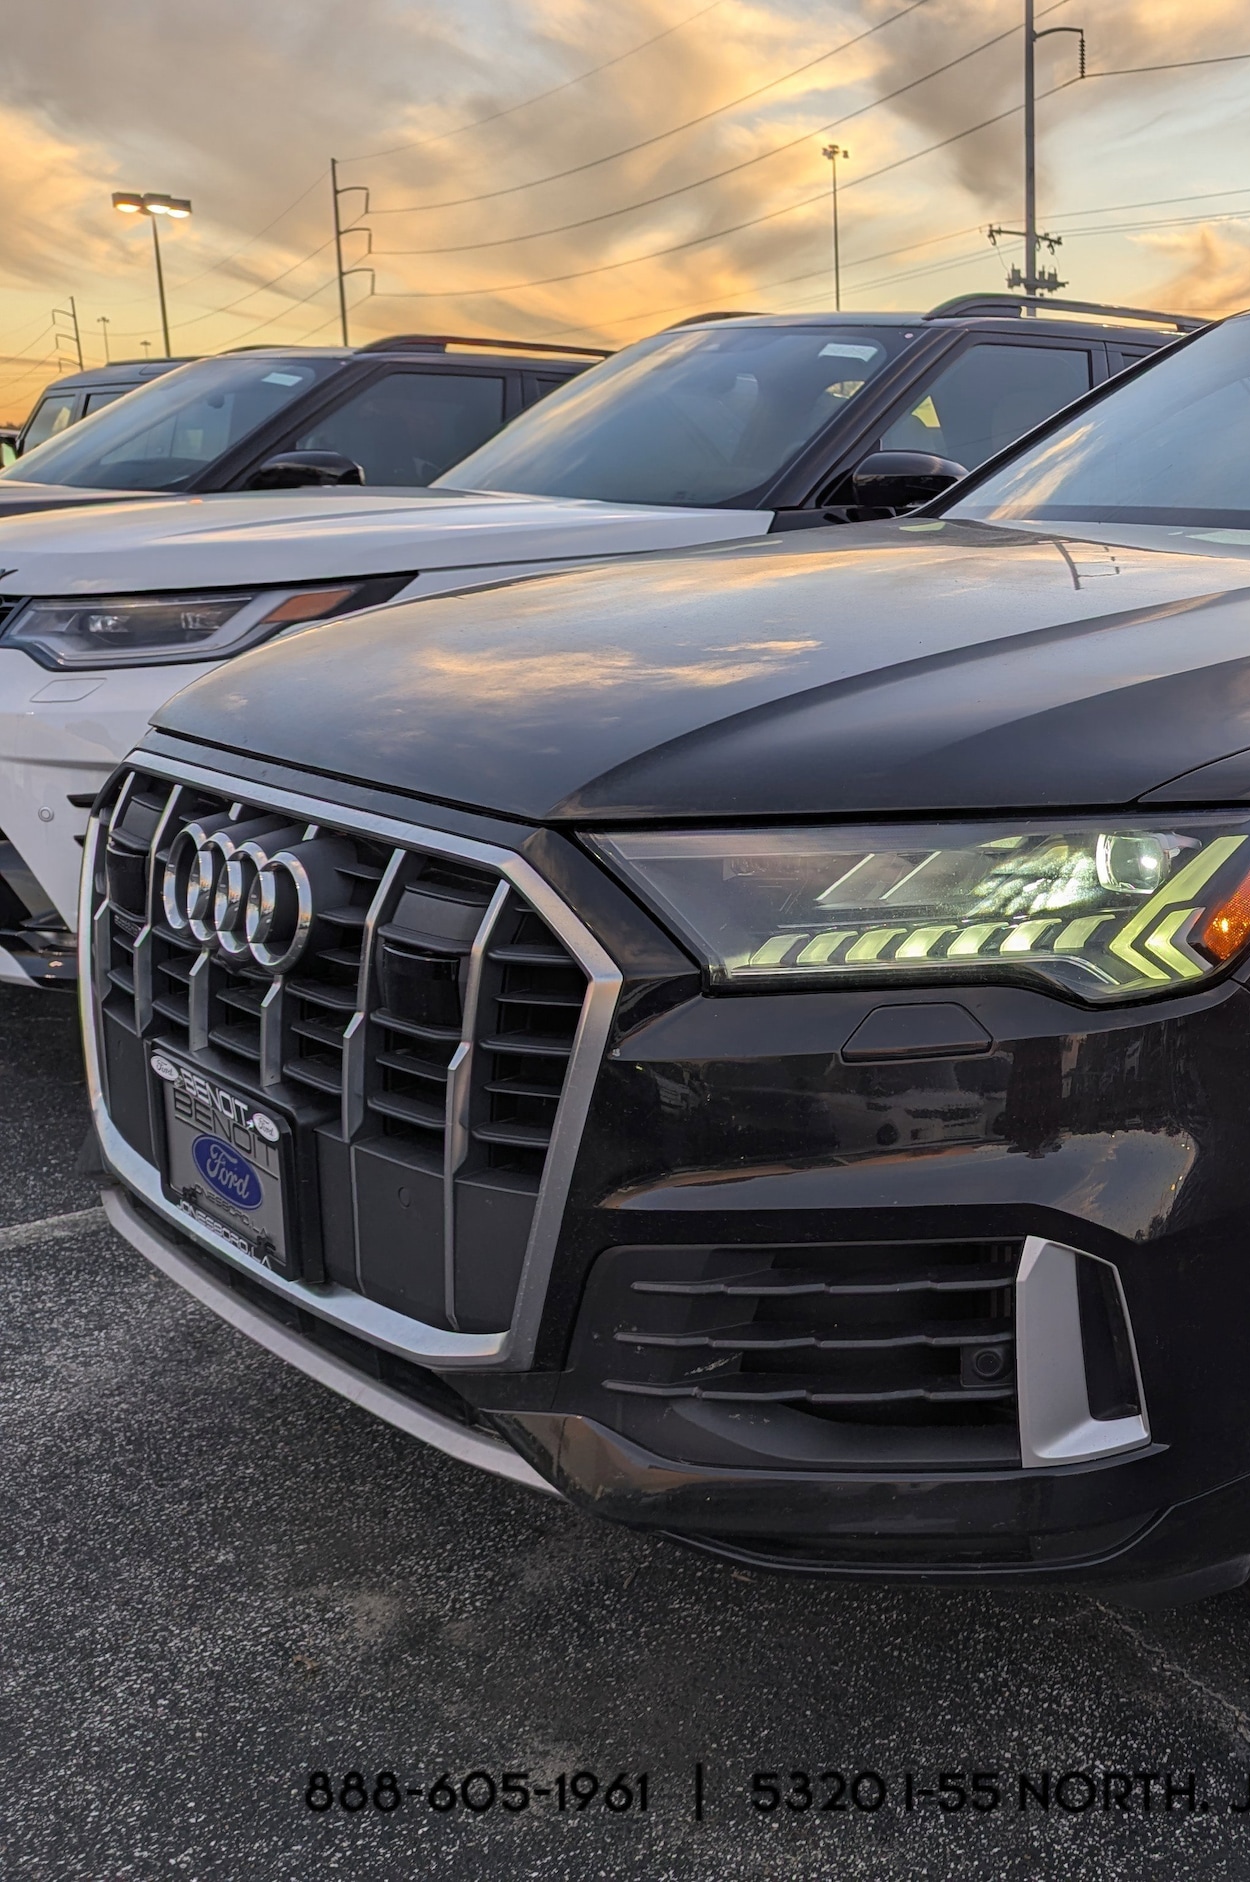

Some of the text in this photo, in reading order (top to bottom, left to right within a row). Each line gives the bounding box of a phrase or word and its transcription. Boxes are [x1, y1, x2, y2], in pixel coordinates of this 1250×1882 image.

[173, 1086, 278, 1167] BENOIT
[180, 1066, 249, 1127] BENOIT
[206, 1144, 250, 1199] Ford
